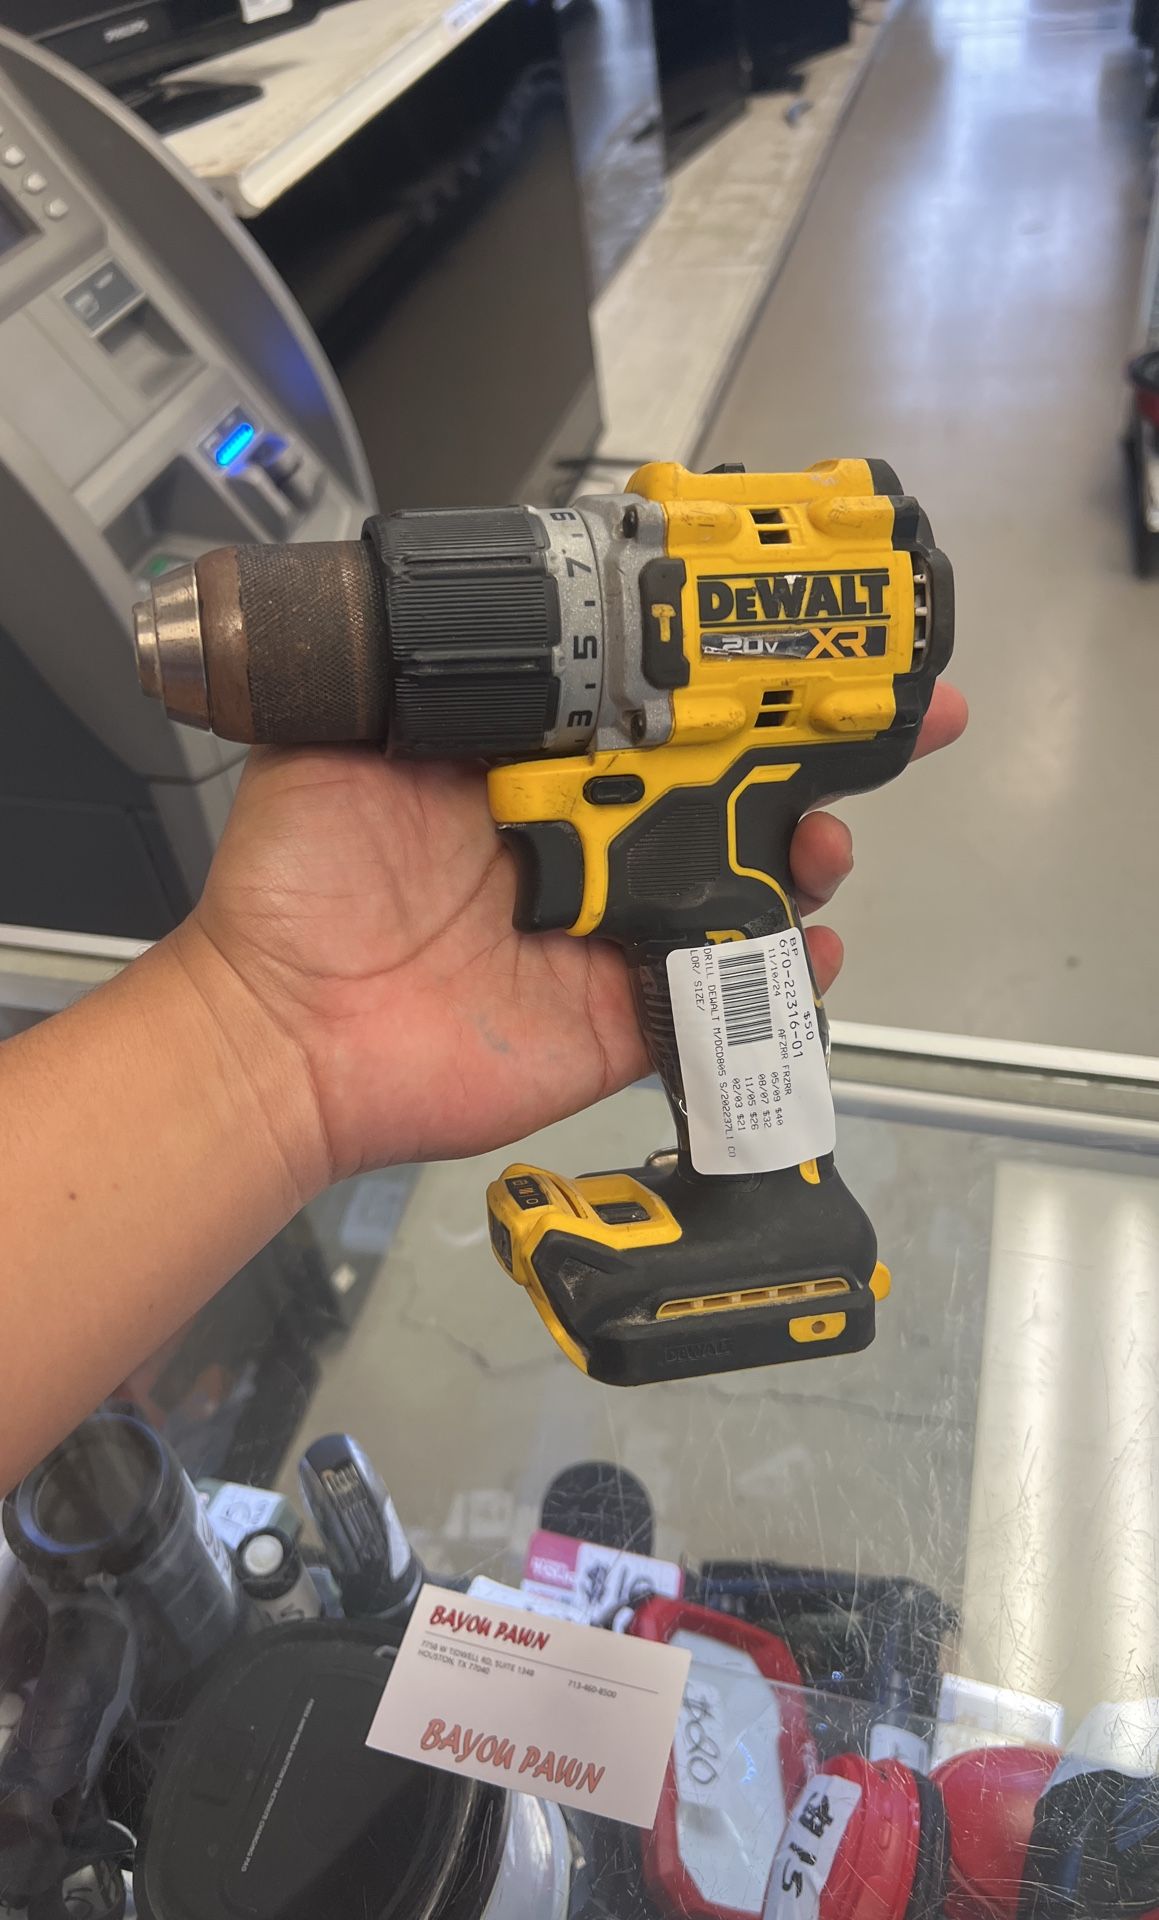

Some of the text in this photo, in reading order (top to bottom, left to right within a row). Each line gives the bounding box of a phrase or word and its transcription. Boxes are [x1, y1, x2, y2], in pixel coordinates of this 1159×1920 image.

[565, 556, 591, 577] 7
[696, 574, 890, 621] DEWALT
[573, 635, 597, 659] 5
[804, 626, 868, 659] XR
[567, 710, 593, 727] 3
[703, 947, 715, 980] DRILL
[790, 937, 799, 956] BP
[690, 949, 705, 1011] LOR/ SIZE/
[768, 948, 781, 996] 11/10/24
[707, 984, 720, 1021] DEWALT
[779, 939, 803, 1058] 670-22316-01
[803, 1011, 815, 1040] $50
[713, 1027, 727, 1077] M/DCD805
[732, 1077, 746, 1131] 02/03 $21
[745, 1076, 759, 1130] 11/05 $26
[758, 1073, 772, 1129] 08/07 $32
[771, 1072, 784, 1126] 05/09 $40
[429, 1605, 551, 1651] BAYOU PAWN
[420, 1718, 606, 1793] BAYOU PAWN
[781, 1791, 834, 1899] $15
